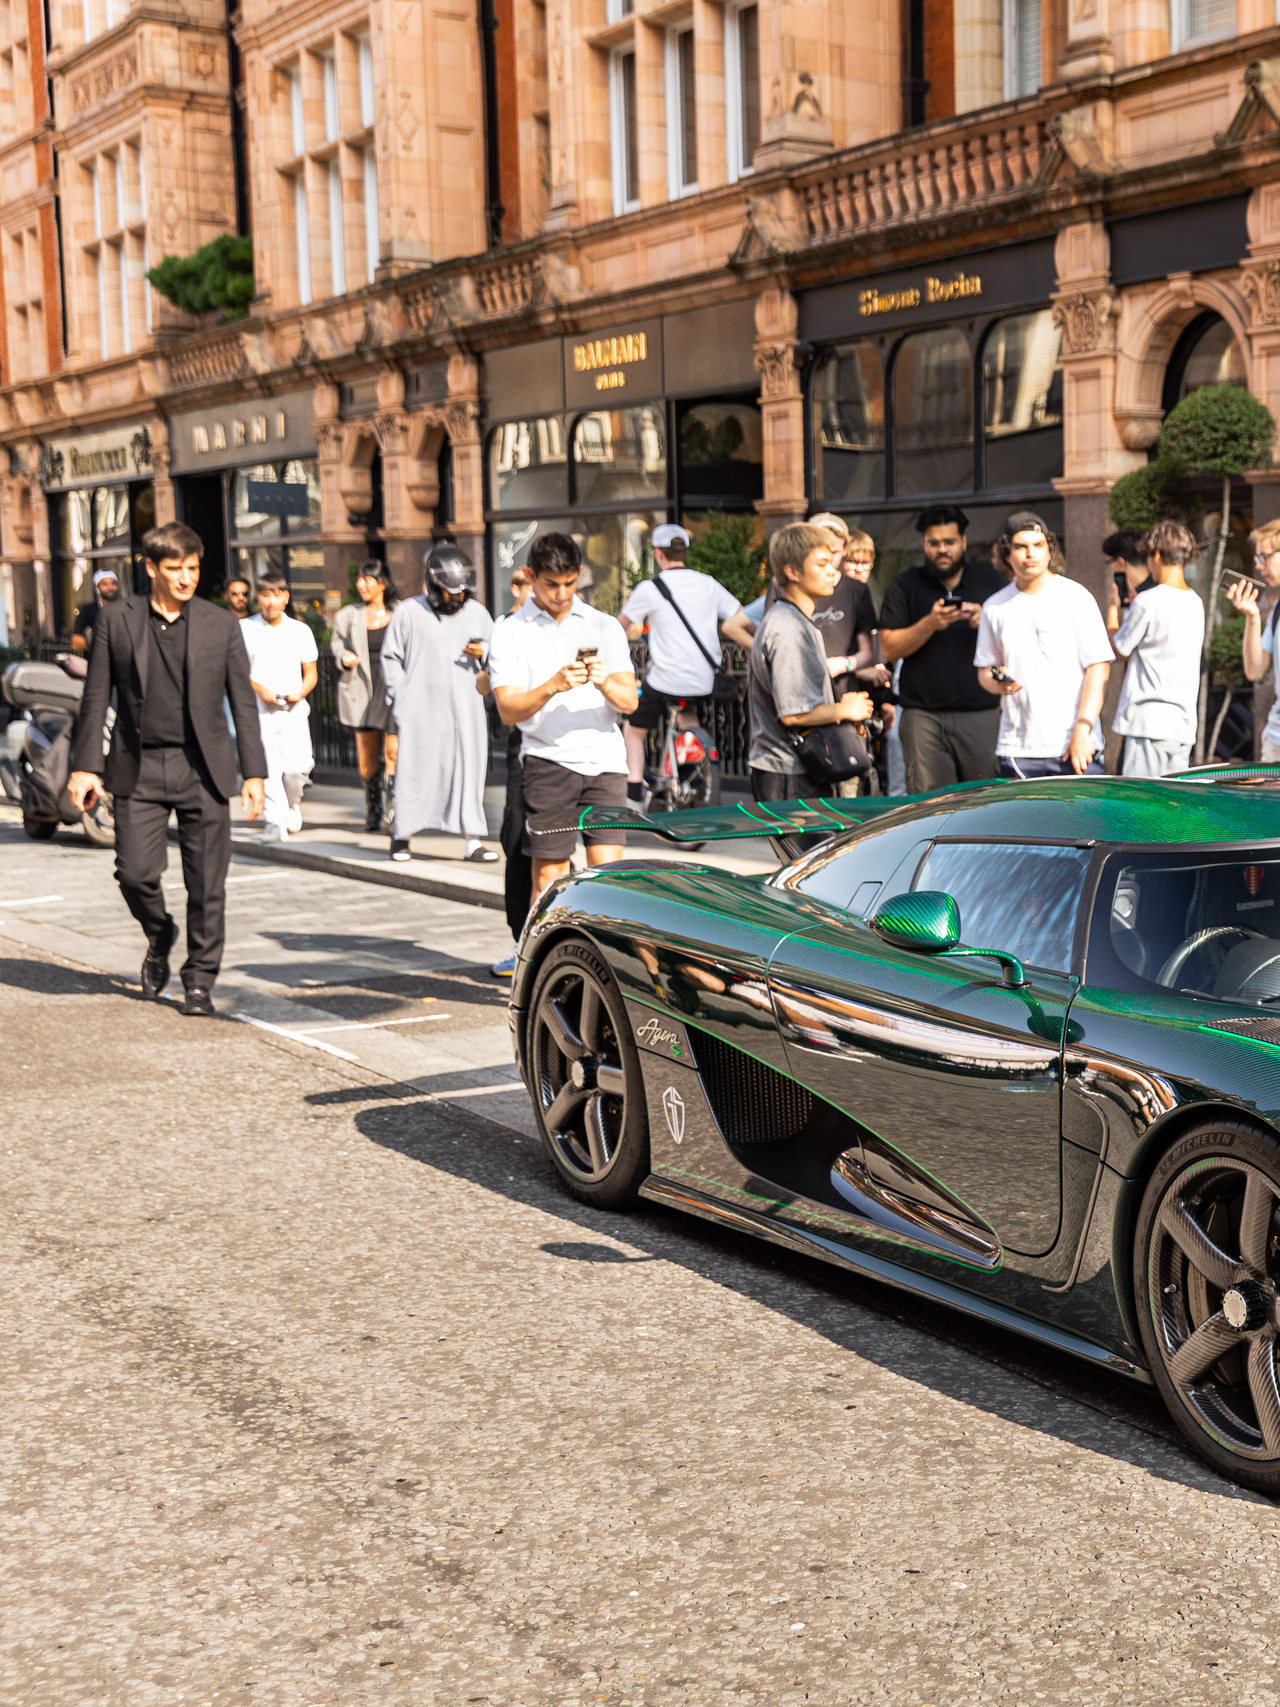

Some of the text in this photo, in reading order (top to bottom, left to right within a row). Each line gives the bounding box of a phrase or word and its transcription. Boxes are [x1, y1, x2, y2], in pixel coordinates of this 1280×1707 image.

[192, 411, 286, 453] MARNI
[567, 944, 608, 981] MICHELIN
[637, 1018, 680, 1046] Agera
[1172, 1133, 1232, 1161] MICHELIN
